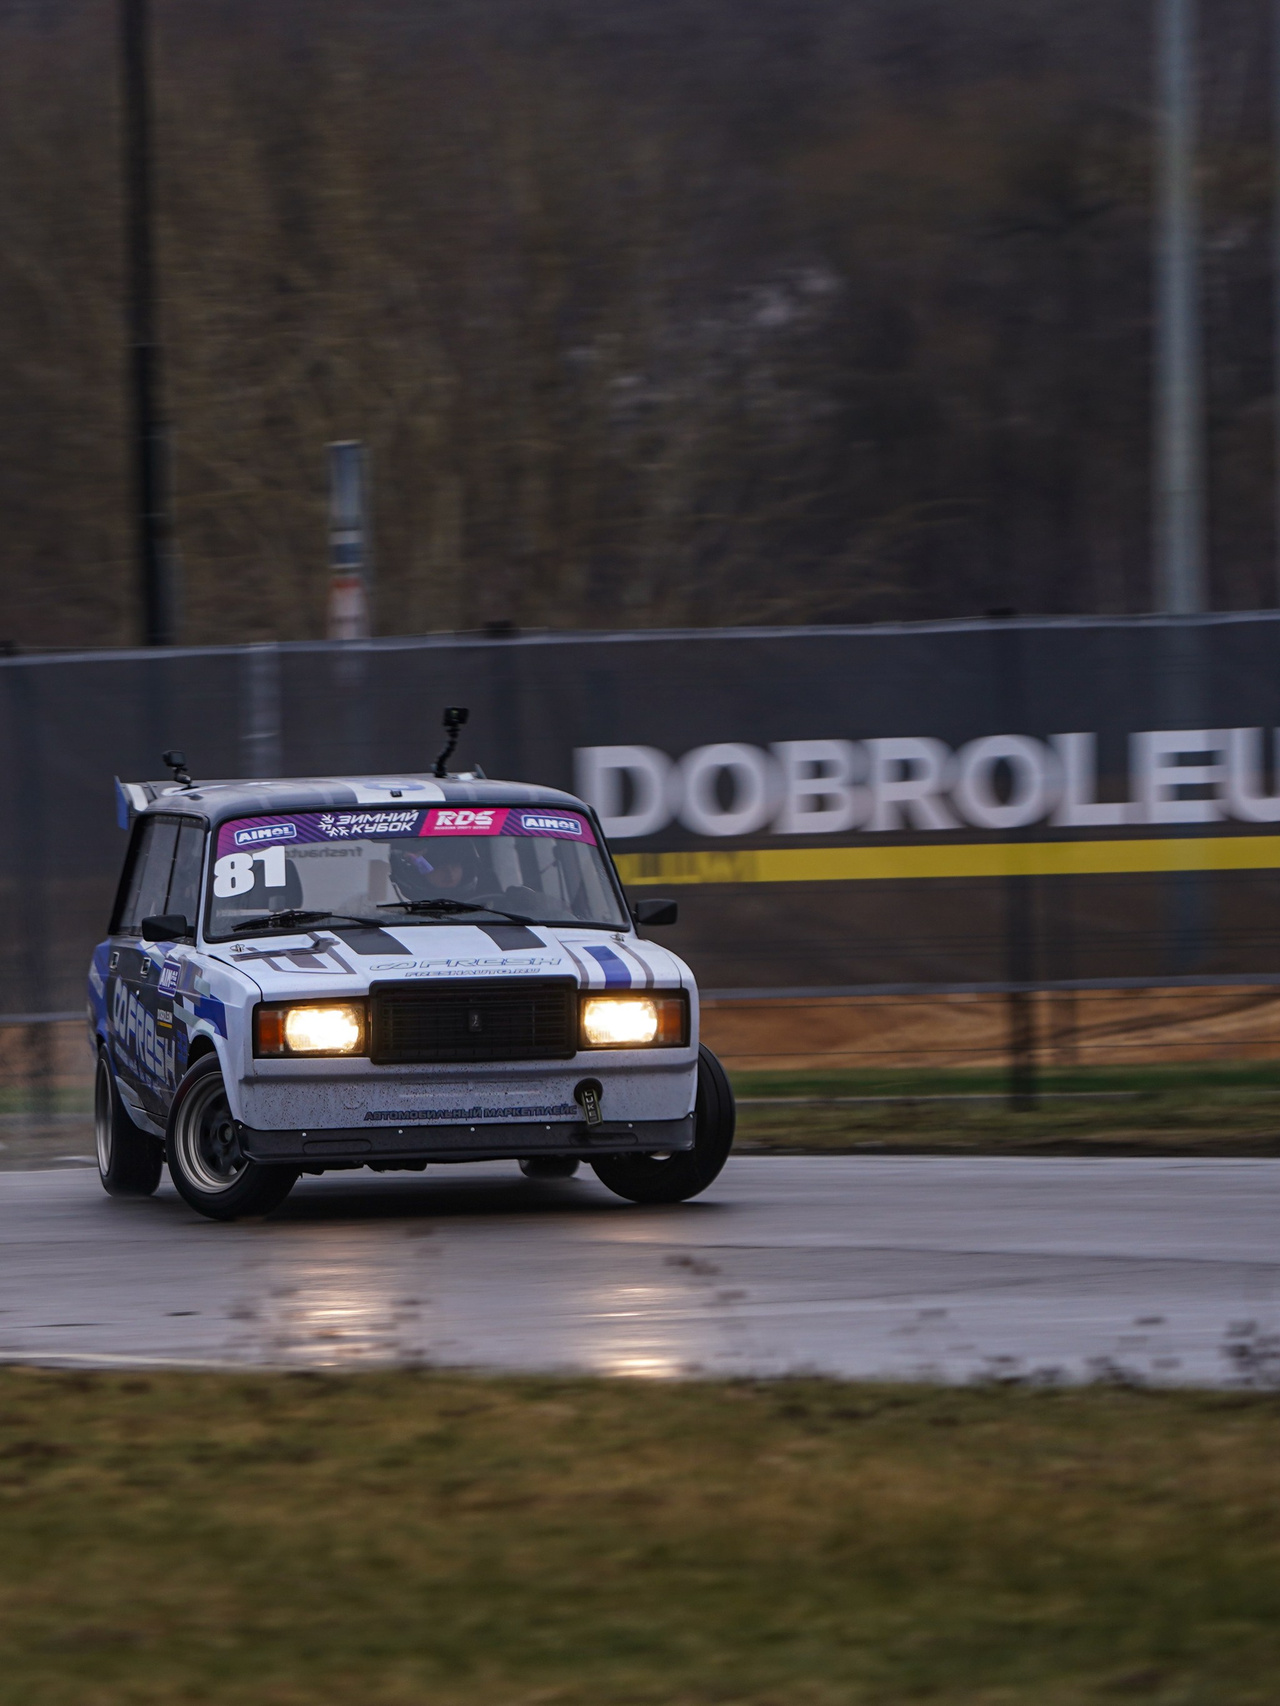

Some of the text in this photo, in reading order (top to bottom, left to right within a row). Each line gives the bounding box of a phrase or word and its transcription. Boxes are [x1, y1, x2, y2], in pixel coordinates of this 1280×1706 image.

[337, 809, 419, 824] ЗИМНИЙ
[436, 811, 495, 826] RDS
[526, 817, 579, 831] AIMOL
[238, 826, 294, 843] AIMOL
[351, 822, 415, 834] КУБОК
[214, 845, 286, 898] 81
[364, 1104, 578, 1121] АВТОМОБИЛЬНЫЙ МАРКЕТПЛЕЙС
